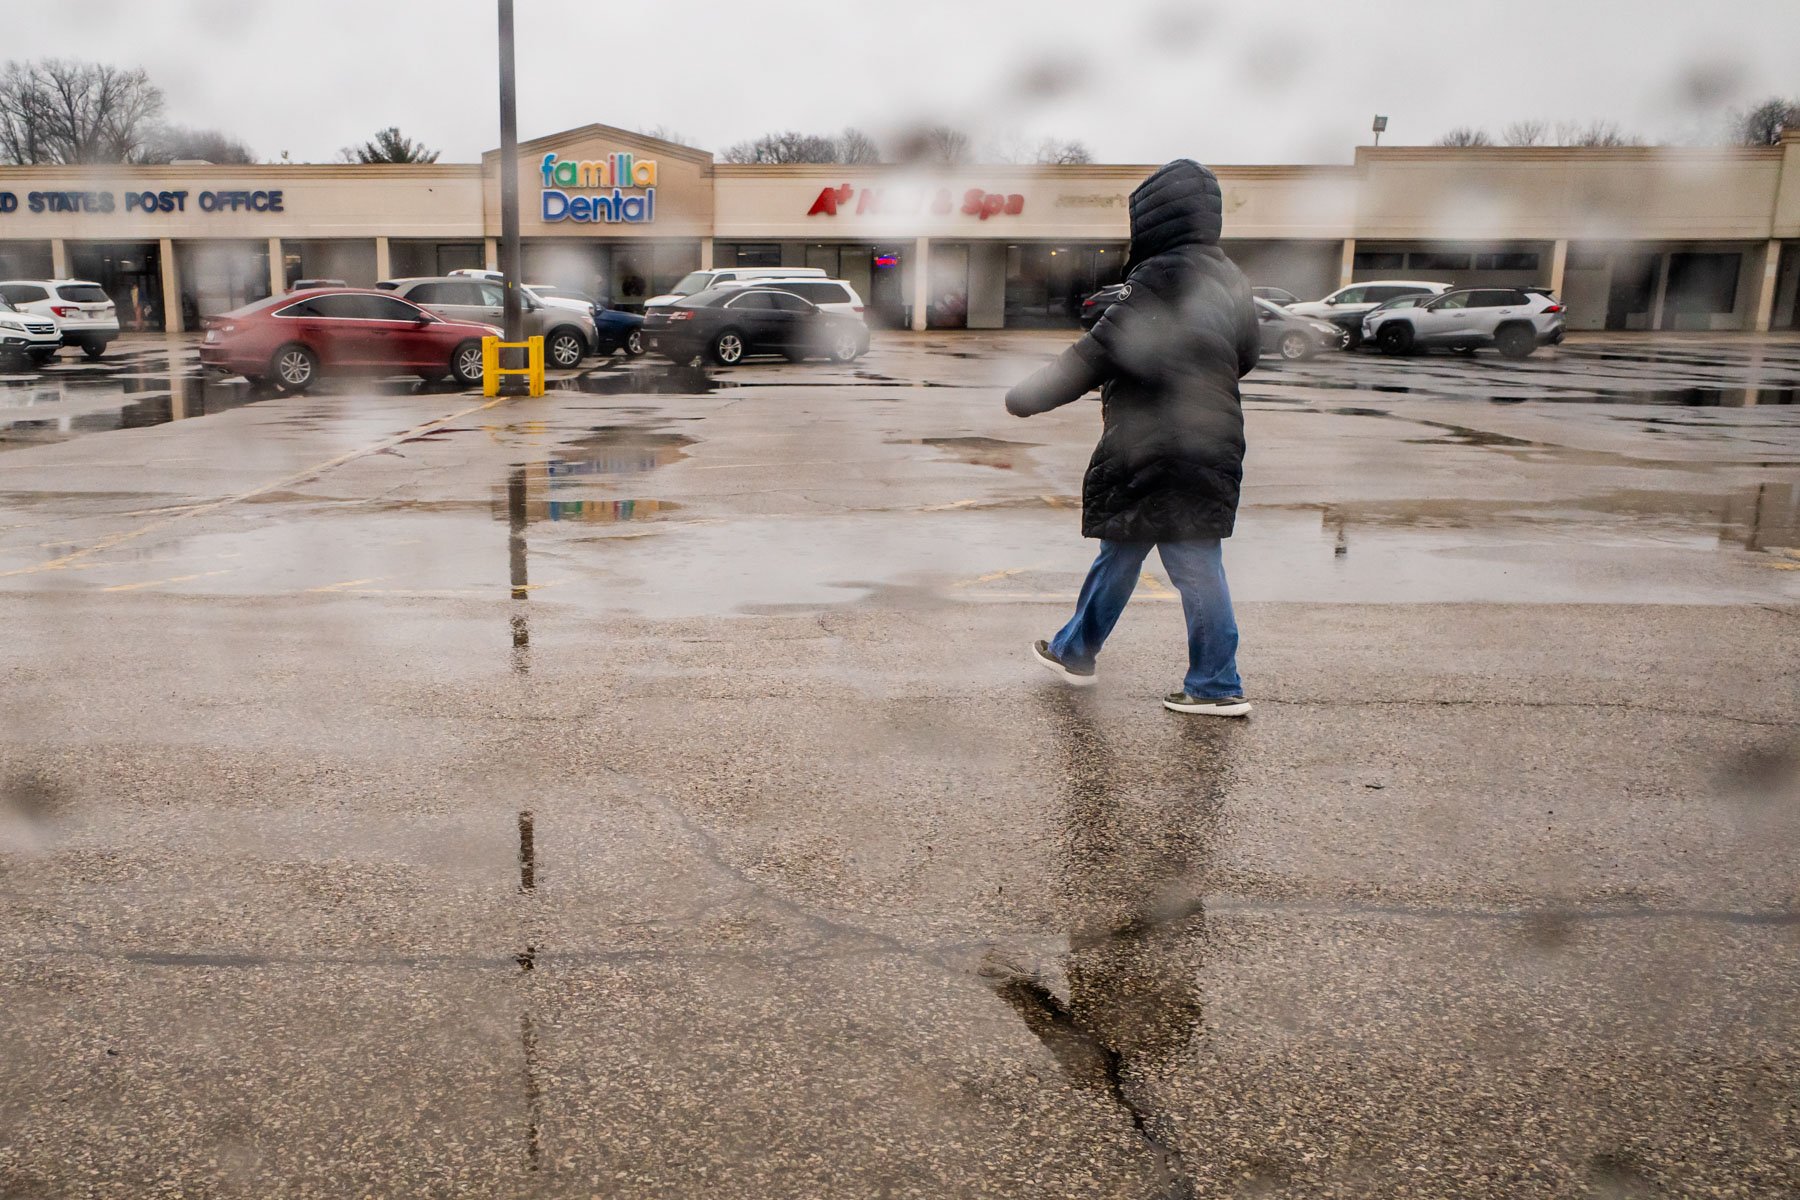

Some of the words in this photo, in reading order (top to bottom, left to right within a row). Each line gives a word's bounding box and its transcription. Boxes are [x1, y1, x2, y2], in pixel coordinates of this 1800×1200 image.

[28, 191, 115, 213] STATES
[125, 191, 188, 213] POST
[199, 191, 284, 213] OFFICE
[542, 188, 654, 222] Dental
[961, 188, 1025, 221] Spa
